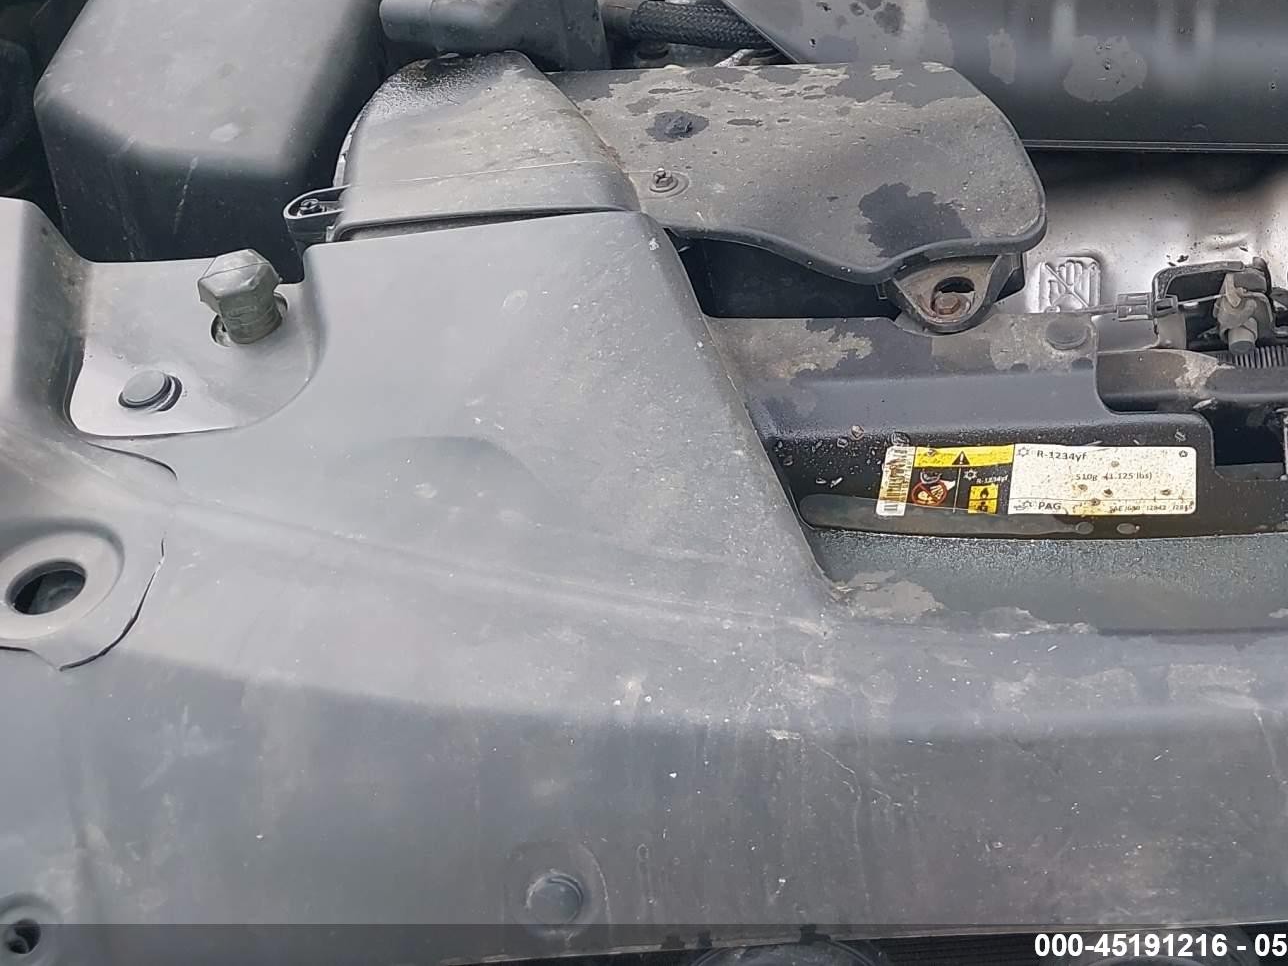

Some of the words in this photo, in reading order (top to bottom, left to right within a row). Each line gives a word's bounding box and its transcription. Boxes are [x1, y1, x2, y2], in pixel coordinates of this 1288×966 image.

[1037, 449, 1087, 462] R-1234yf
[1076, 473, 1098, 482] 510g
[1104, 472, 1134, 481] (1.125
[1136, 472, 1153, 481] lbs)
[1038, 501, 1062, 511] PAG
